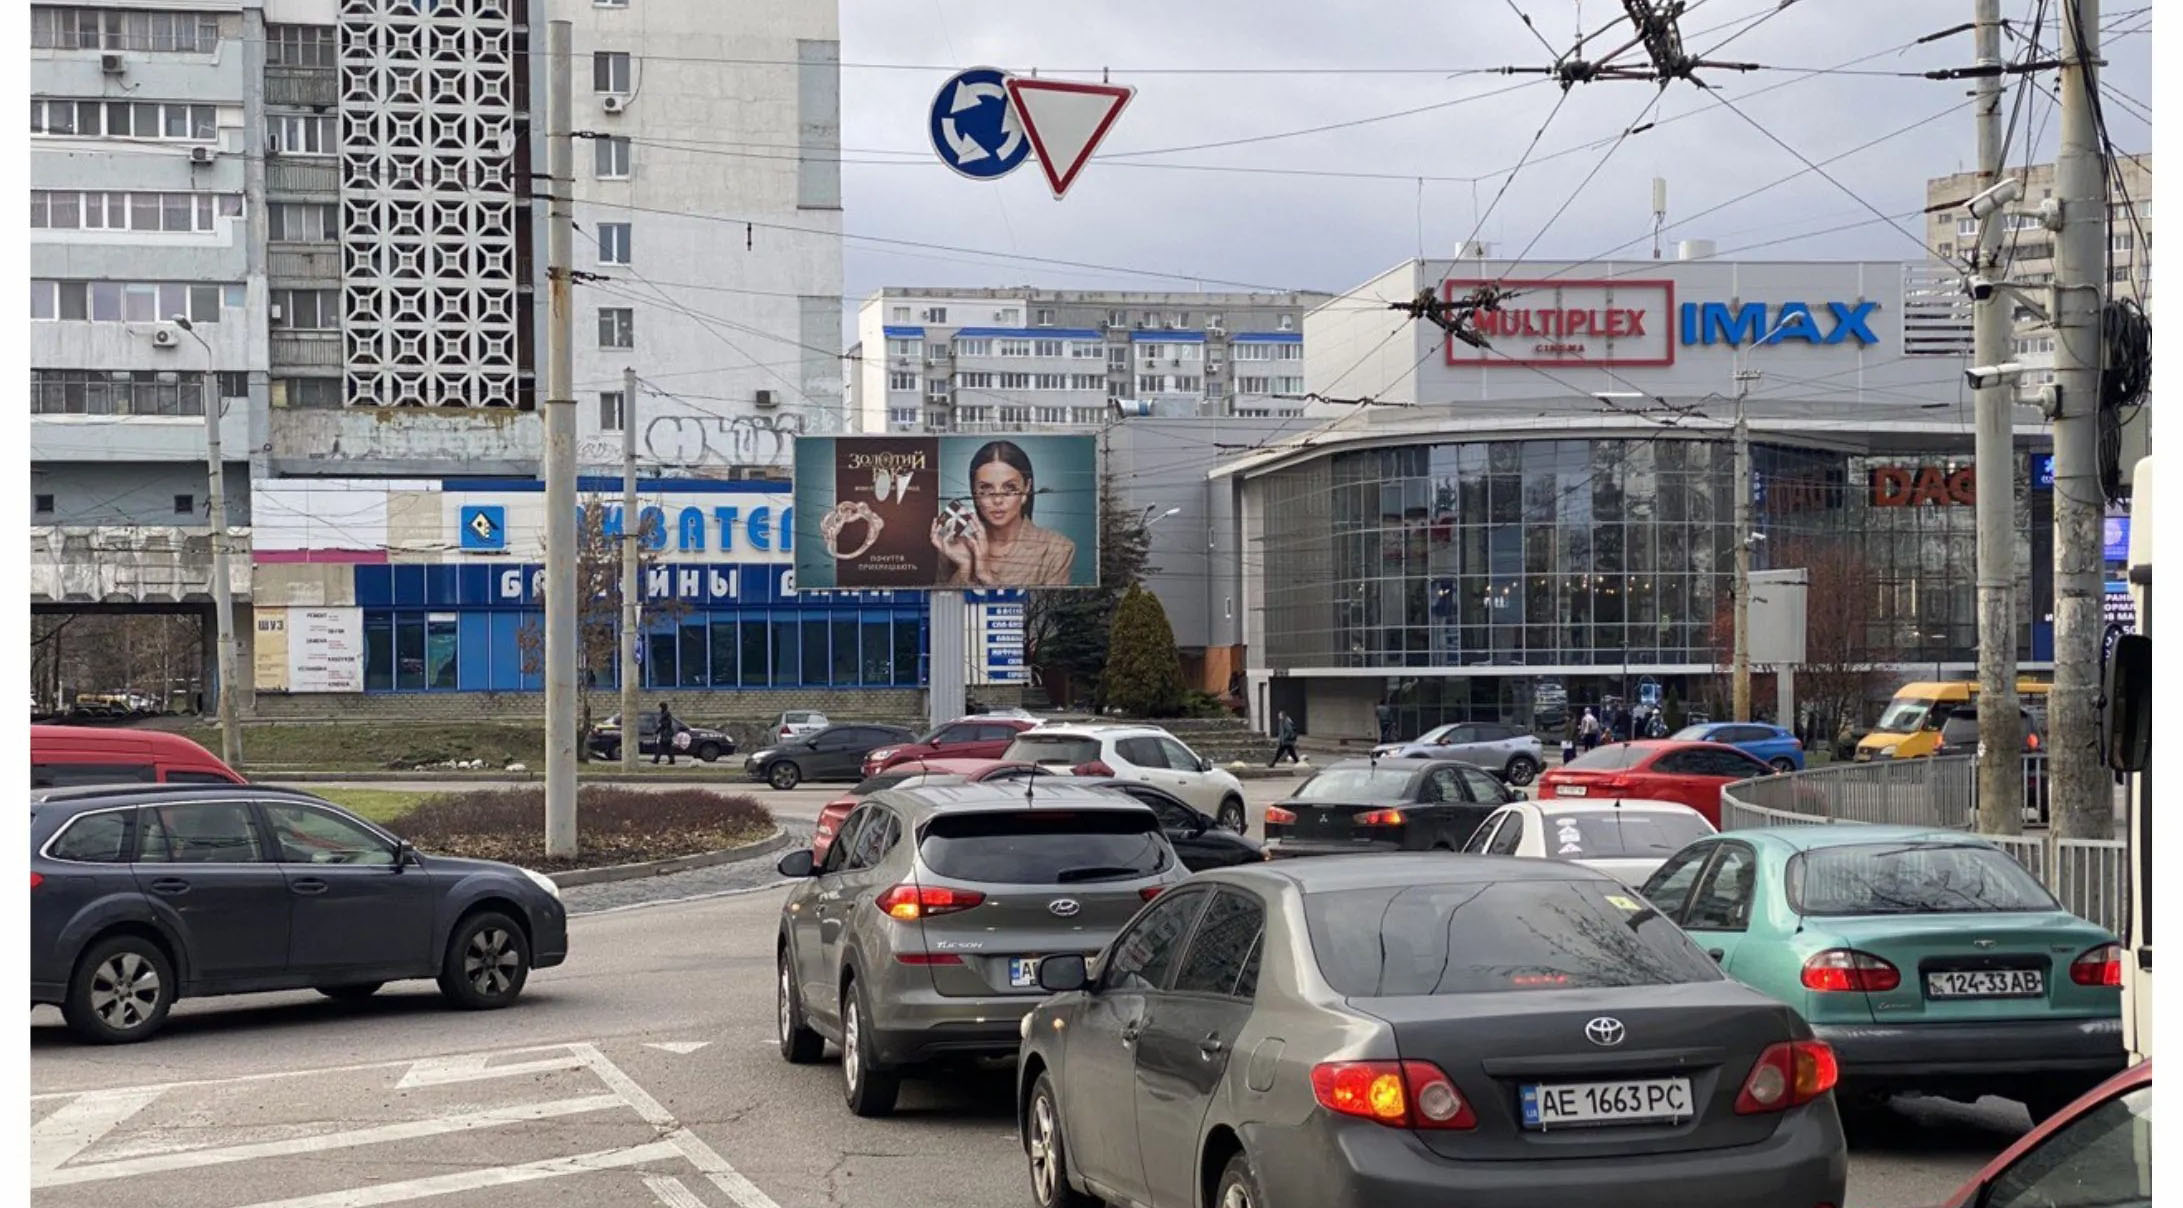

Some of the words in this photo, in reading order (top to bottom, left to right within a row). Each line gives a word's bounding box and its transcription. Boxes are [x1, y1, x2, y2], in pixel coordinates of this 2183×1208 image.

[1472, 308, 1646, 337] MULTIPLEX
[1680, 301, 1880, 346] IMAX
[1533, 343, 1586, 354] CINEMA
[258, 620, 285, 631] ШУЗ
[1543, 1089, 1578, 1116] AE
[1586, 1086, 1642, 1114] 1663
[1647, 1084, 1685, 1112] PC
